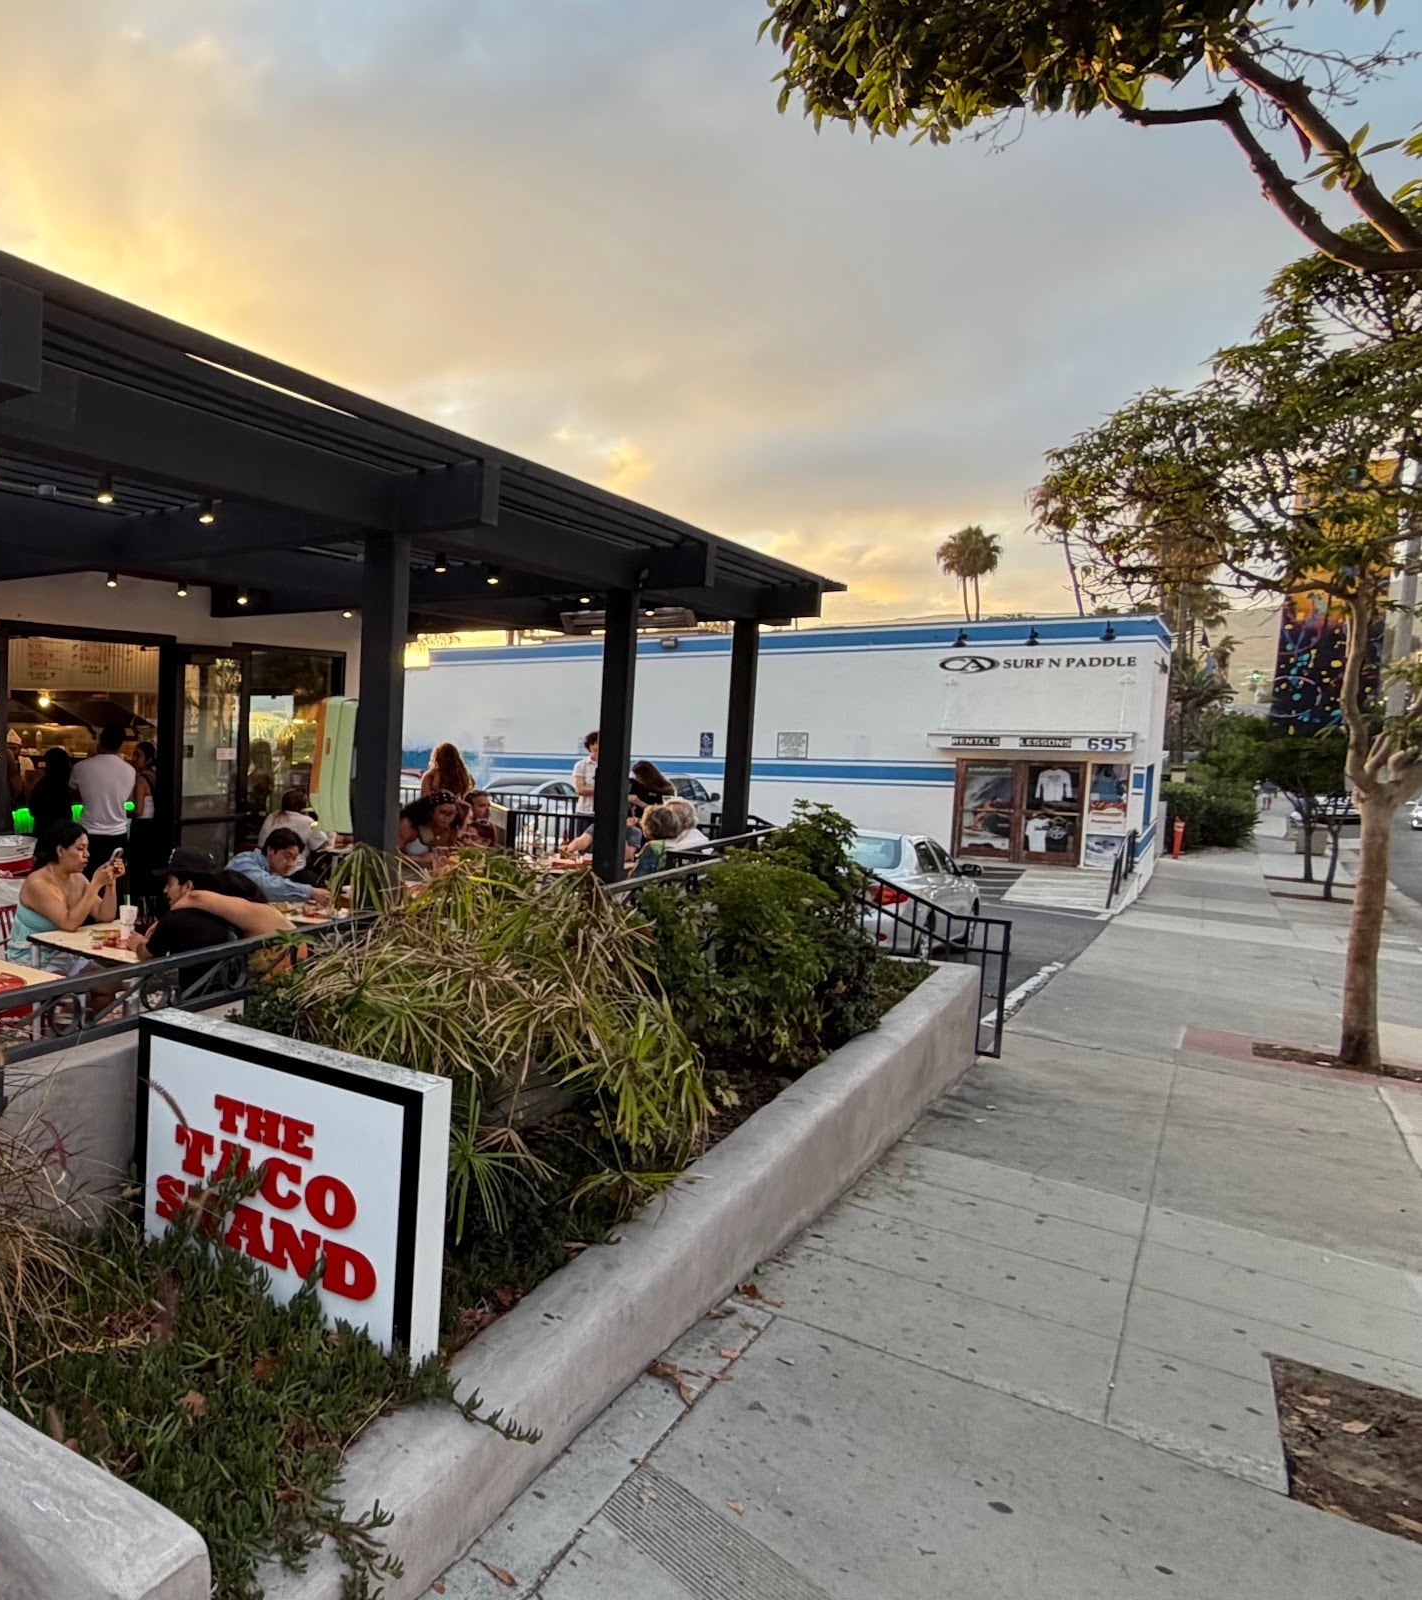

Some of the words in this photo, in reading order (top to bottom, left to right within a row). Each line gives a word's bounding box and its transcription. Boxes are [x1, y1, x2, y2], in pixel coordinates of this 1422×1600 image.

[1002, 658, 1045, 669] SURF
[1048, 658, 1062, 668] N
[1065, 656, 1137, 668] PADDLE
[951, 737, 1000, 746] RENTALS
[1019, 738, 1072, 747] LESSONS
[1087, 738, 1127, 751] 695
[214, 1093, 315, 1161] THE
[155, 1174, 377, 1301] SAND
